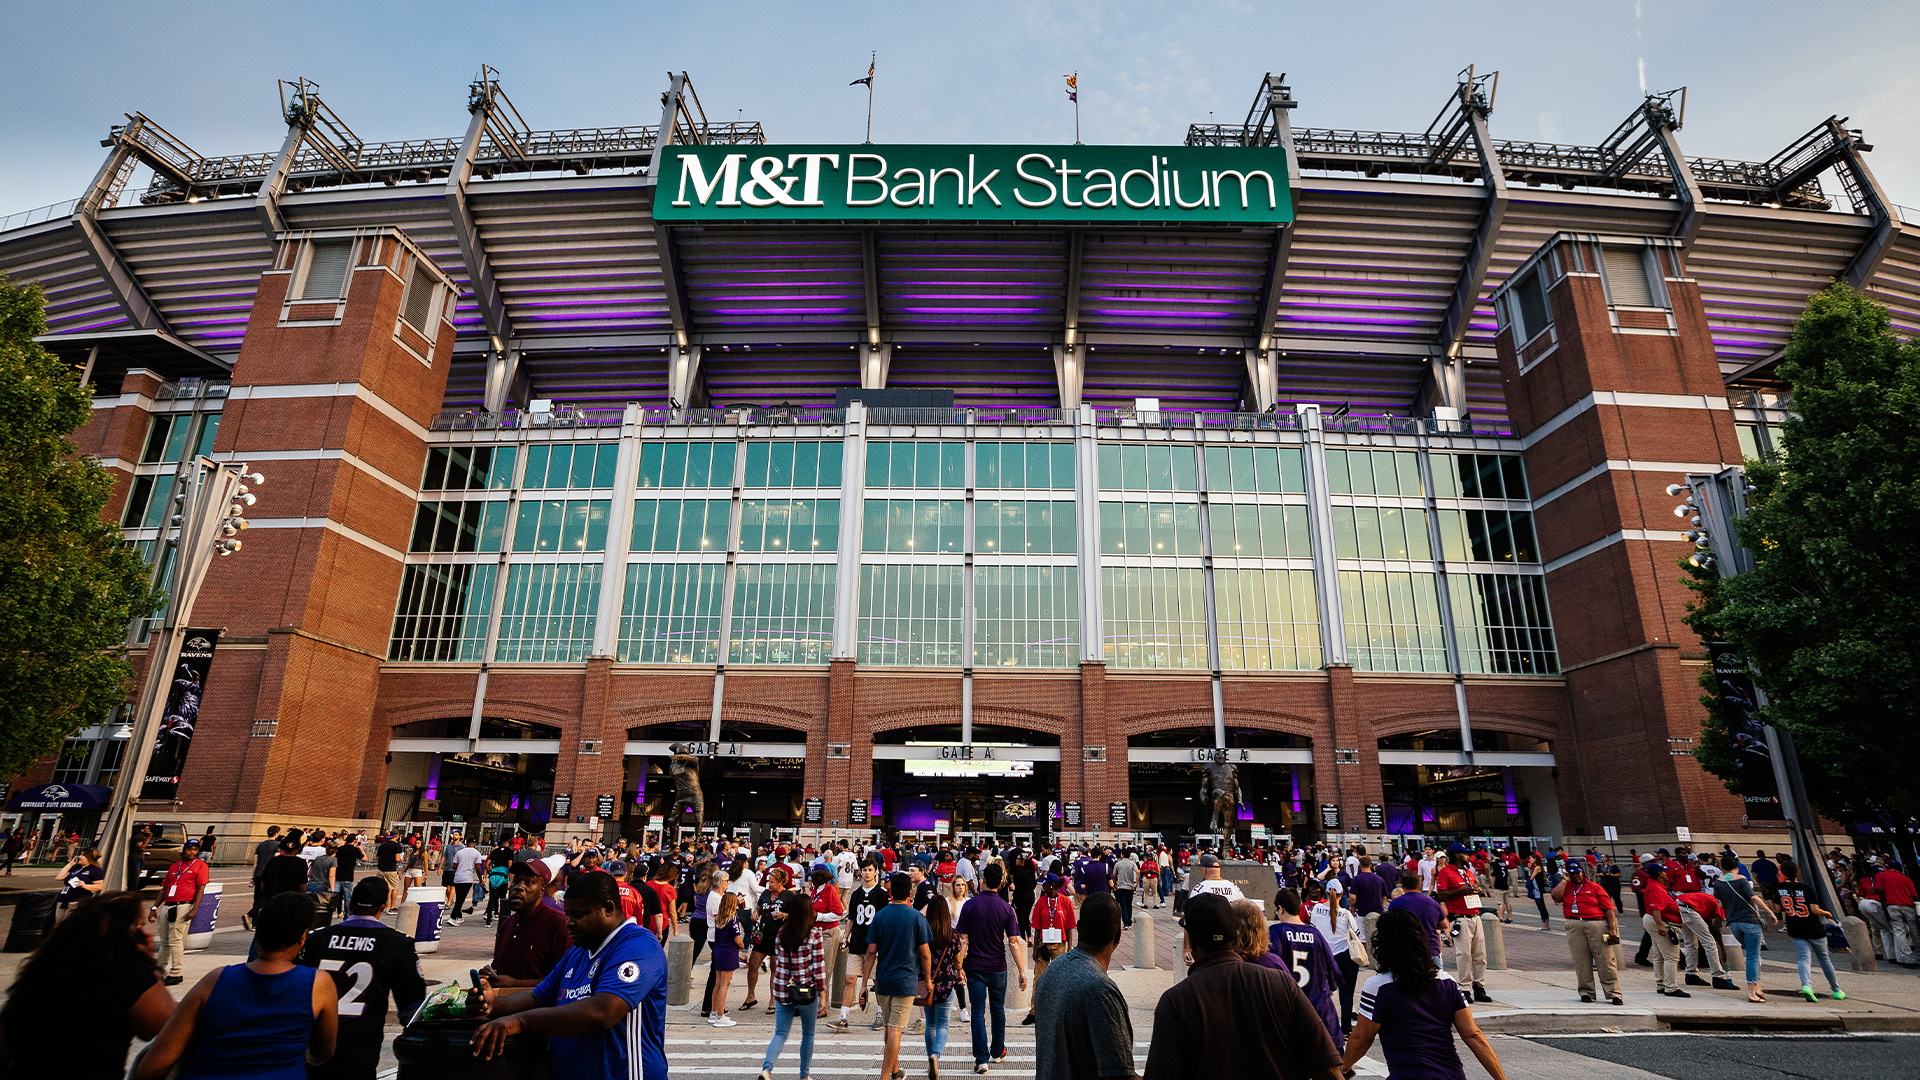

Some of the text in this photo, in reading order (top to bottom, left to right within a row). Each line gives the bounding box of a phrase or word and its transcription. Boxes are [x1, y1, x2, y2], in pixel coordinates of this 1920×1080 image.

[671, 153, 1277, 210] M&T Bank Stadium
[688, 742, 736, 755] GATE A
[942, 746, 992, 759] GATE A
[1198, 748, 1246, 761] GAE A
[144, 775, 171, 783] SAFEWAY
[680, 873, 686, 885] 5
[1210, 887, 1233, 896] TAYLOR
[856, 904, 876, 926] 89
[1316, 907, 1346, 918] BALTRE
[328, 935, 377, 952] R.LEWIS
[1286, 930, 1315, 944] FLACCO
[1292, 950, 1311, 988] 5
